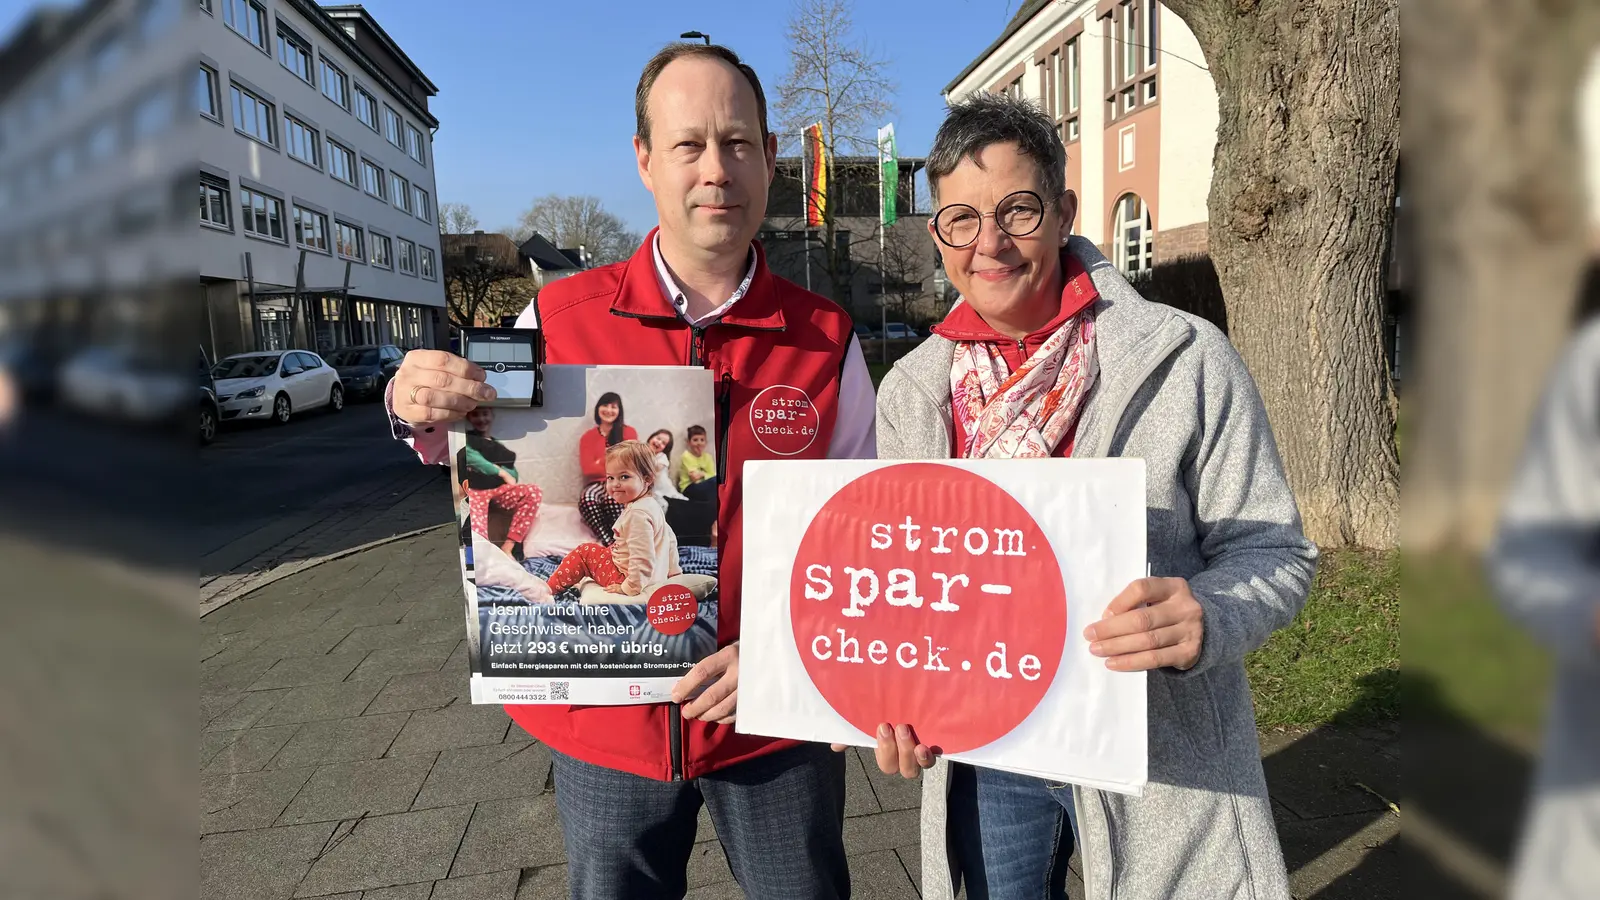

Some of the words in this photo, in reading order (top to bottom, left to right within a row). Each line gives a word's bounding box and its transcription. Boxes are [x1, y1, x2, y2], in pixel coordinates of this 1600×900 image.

[771, 397, 809, 408] strom
[754, 408, 807, 422] spar-
[757, 424, 815, 436] check.de
[870, 515, 1027, 556] strom
[662, 592, 691, 602] strom
[804, 564, 1012, 617] spar-
[488, 602, 541, 616] Jasmin
[547, 603, 575, 616] und
[581, 603, 610, 616] ihre
[649, 602, 690, 615] spar-
[652, 612, 696, 625] check.de
[489, 621, 583, 635] Geschwister
[588, 622, 635, 635] haben
[490, 640, 523, 656] jetzt
[527, 641, 556, 654] 293
[559, 641, 569, 654] €
[574, 641, 616, 654] mehr
[621, 641, 668, 656] übrig.
[811, 628, 1042, 681] check.de
[519, 662, 569, 670] Energiesparen
